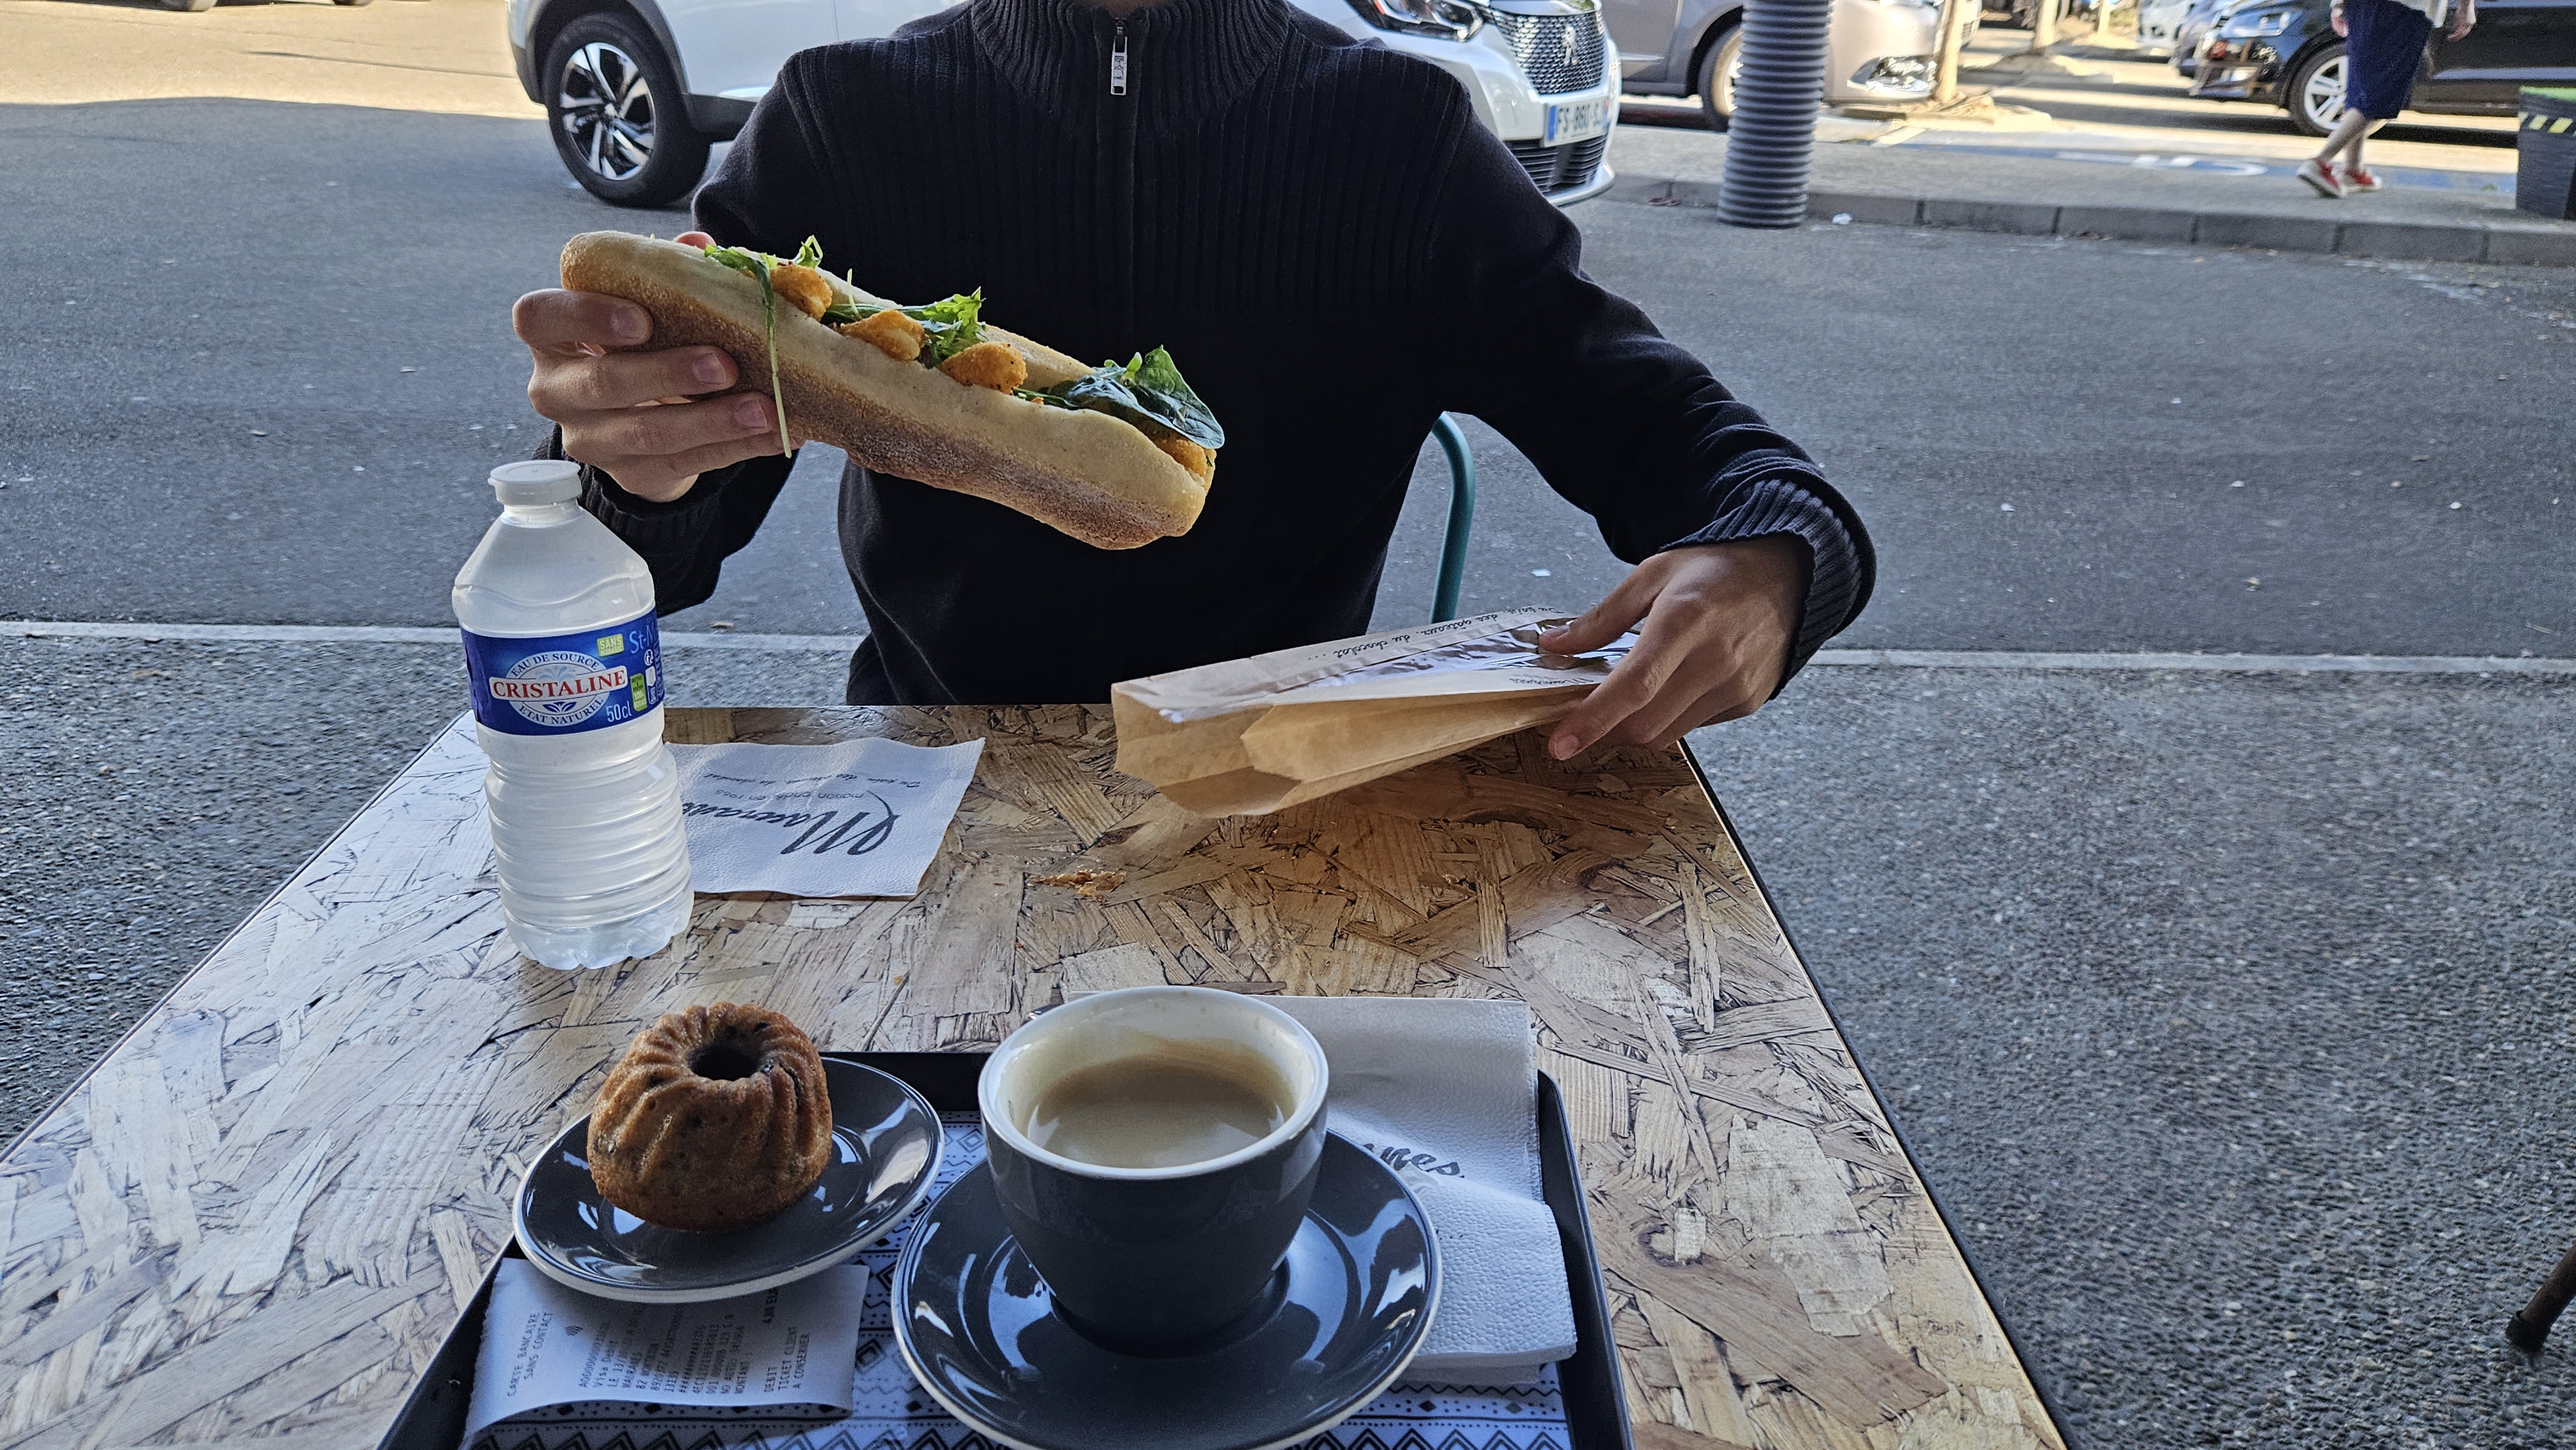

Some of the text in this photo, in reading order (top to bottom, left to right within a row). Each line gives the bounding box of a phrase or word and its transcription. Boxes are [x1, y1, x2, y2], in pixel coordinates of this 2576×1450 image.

[1475, 614, 1498, 625] des
[600, 636, 621, 650] SANS
[511, 653, 600, 677] EAU DE SOURCE
[493, 670, 626, 699] CRISTALINE
[551, 699, 604, 725] NATUREL
[606, 701, 632, 722] 50cl
[818, 792, 866, 800] maison
[507, 1312, 540, 1397] CARTE BANCAIRE
[524, 1312, 553, 1380] SANS CONTACT
[591, 1368, 607, 1388] Visa
[608, 1378, 620, 1388] LE
[777, 1361, 791, 1391] TICKET
